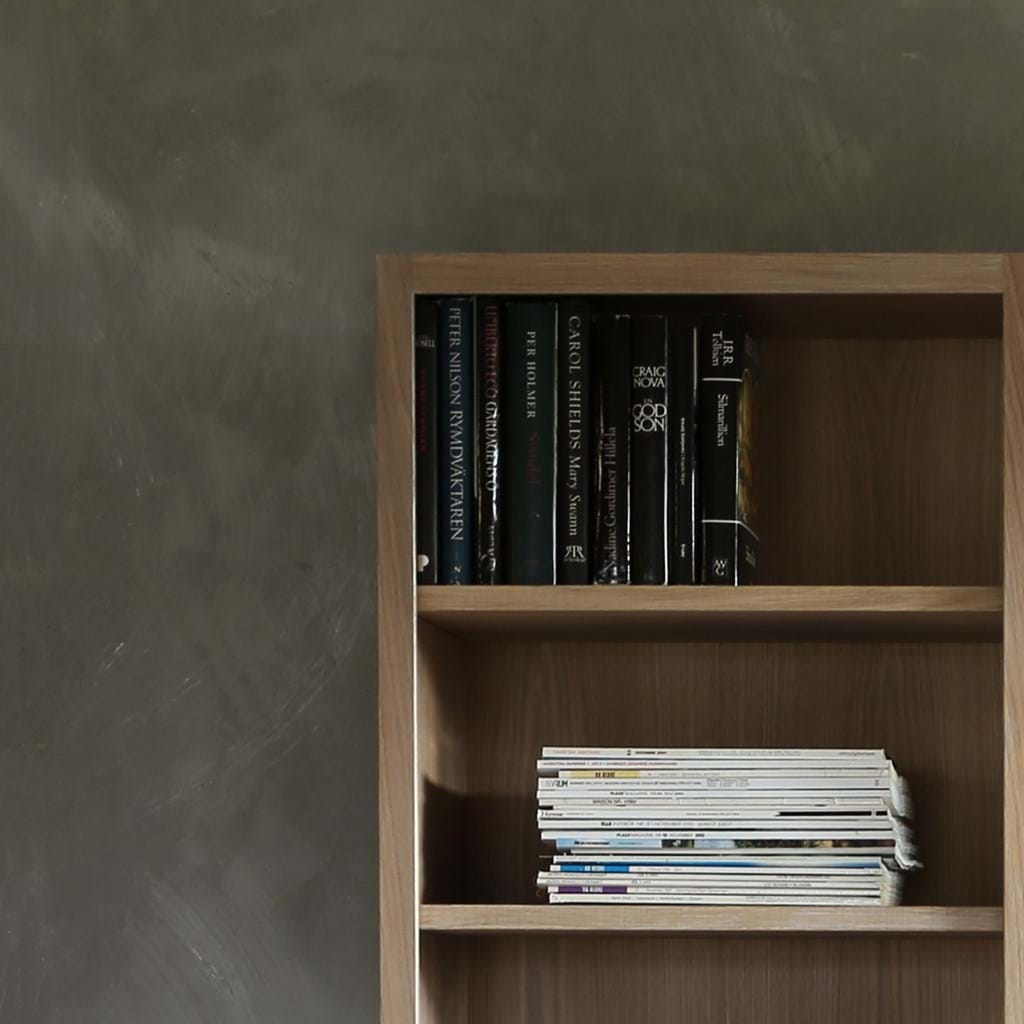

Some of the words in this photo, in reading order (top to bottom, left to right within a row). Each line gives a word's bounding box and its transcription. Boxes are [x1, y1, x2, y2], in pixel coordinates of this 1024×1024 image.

[449, 307, 461, 347] PETER
[526, 331, 536, 357] PER
[568, 315, 581, 374] CAROL
[711, 331, 723, 367] Tolkien
[449, 352, 462, 405] NILSON
[526, 361, 536, 419] HOLMER
[632, 366, 665, 377] CRAIG
[633, 377, 665, 388] NOVA
[568, 380, 581, 450] SHIELDS
[632, 403, 667, 417] GOD
[634, 417, 665, 432] SON
[717, 393, 729, 447] Silmarillion
[449, 410, 465, 541] RYMDVÄKTAREN
[566, 455, 580, 491] Mary
[568, 494, 580, 536] Swann
